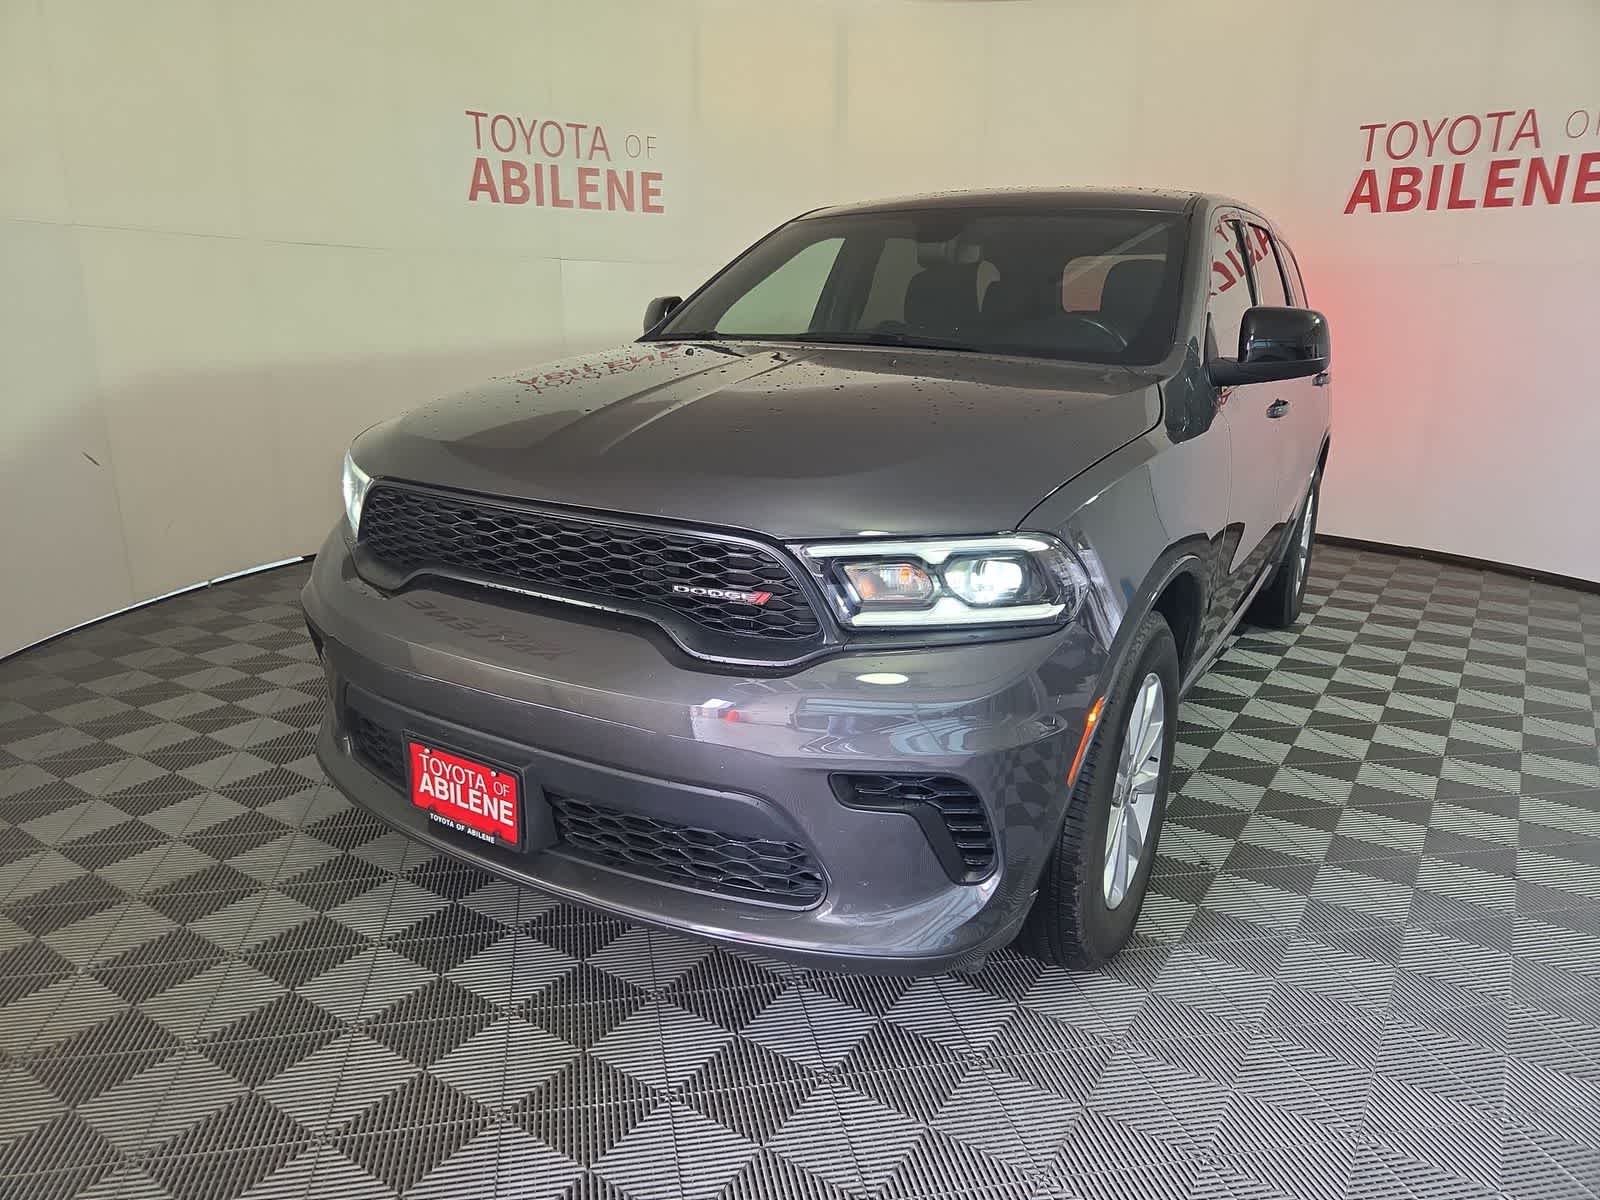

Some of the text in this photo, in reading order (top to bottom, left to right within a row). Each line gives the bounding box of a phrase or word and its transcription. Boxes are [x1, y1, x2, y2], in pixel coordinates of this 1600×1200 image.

[465, 110, 657, 162] TOYOTA OF
[1359, 108, 1600, 162] TOYOTA O
[468, 157, 665, 214] ABILENE
[1343, 151, 1600, 215] ABILENE
[673, 585, 758, 604] DODGE
[419, 753, 510, 797] TOYOTA OF
[419, 772, 514, 827] ABILENE
[429, 812, 495, 844] TOYOTA OF ABILENE
